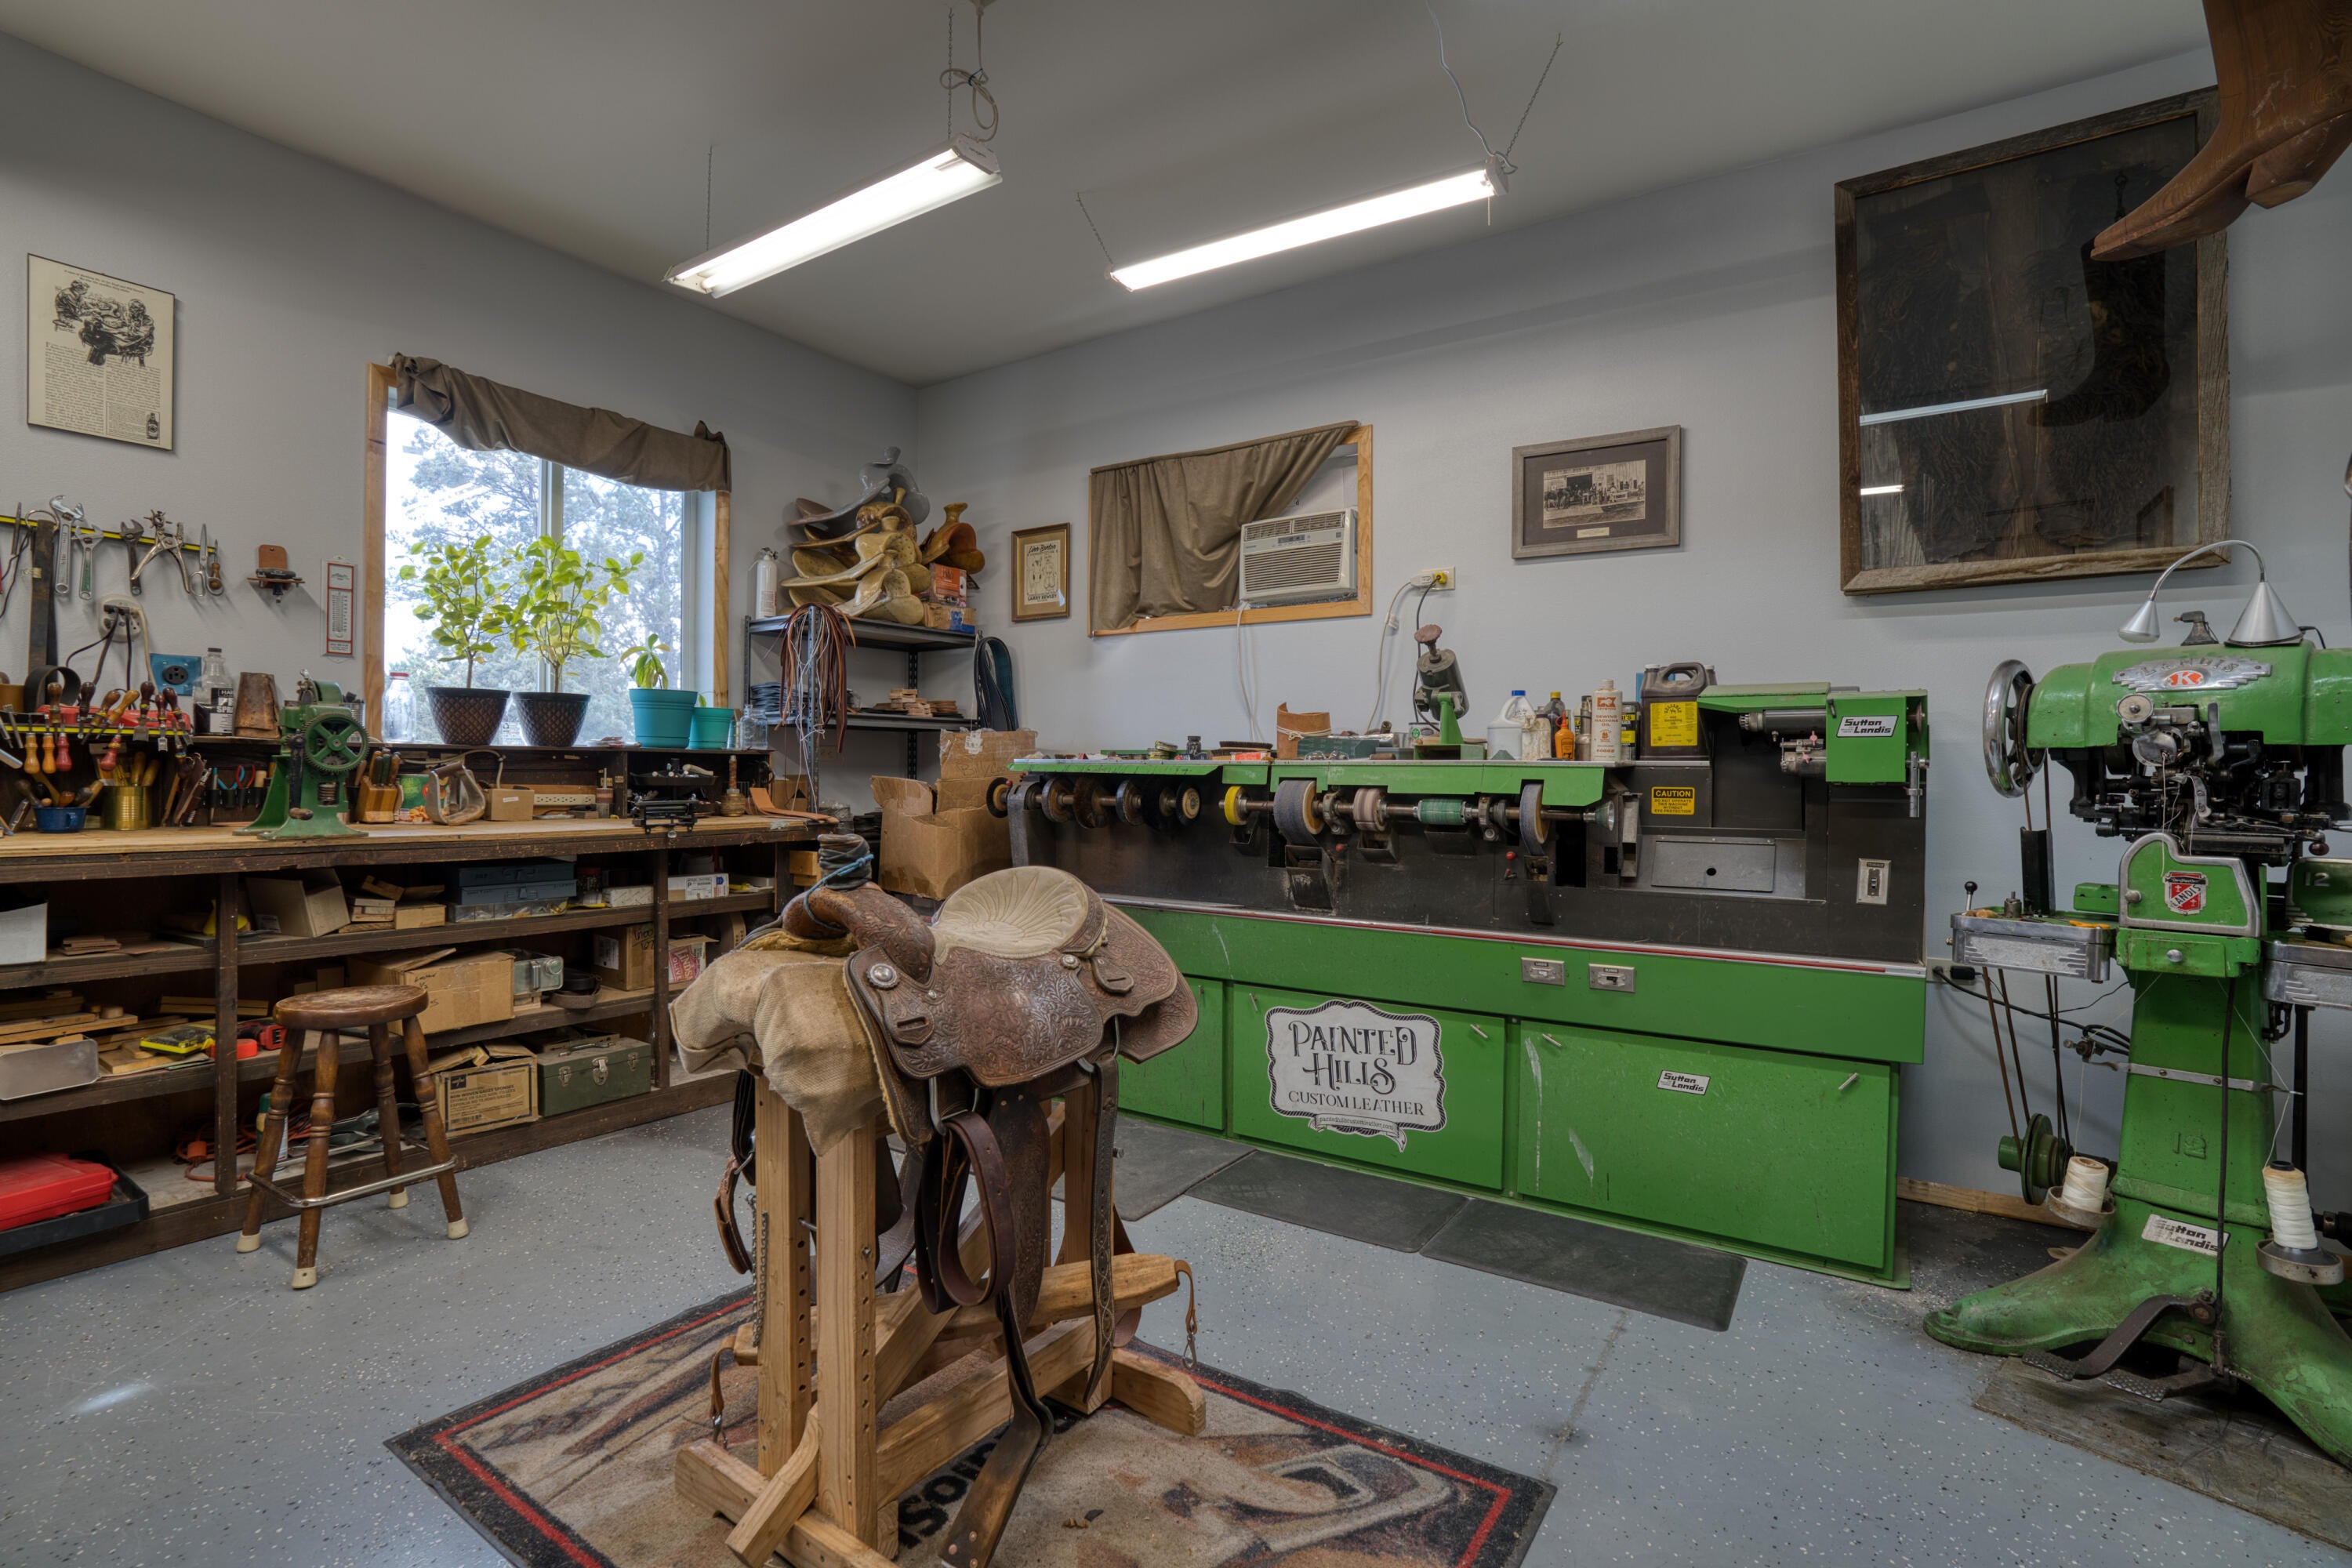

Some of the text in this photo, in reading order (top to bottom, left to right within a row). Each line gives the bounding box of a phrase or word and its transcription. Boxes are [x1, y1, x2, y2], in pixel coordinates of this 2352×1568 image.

[2140, 657, 2240, 677] LANDIS
[2177, 671, 2195, 685] K
[2305, 872, 2330, 887] 12
[2170, 884, 2201, 907] LANDIS
[1288, 1020, 1417, 1065] PAINTED
[1302, 1052, 1396, 1095] HILLS
[1663, 1072, 1697, 1083] Sutton
[1671, 1081, 1704, 1091] Landis
[1288, 1091, 1425, 1116] CUSTOM LEATHER
